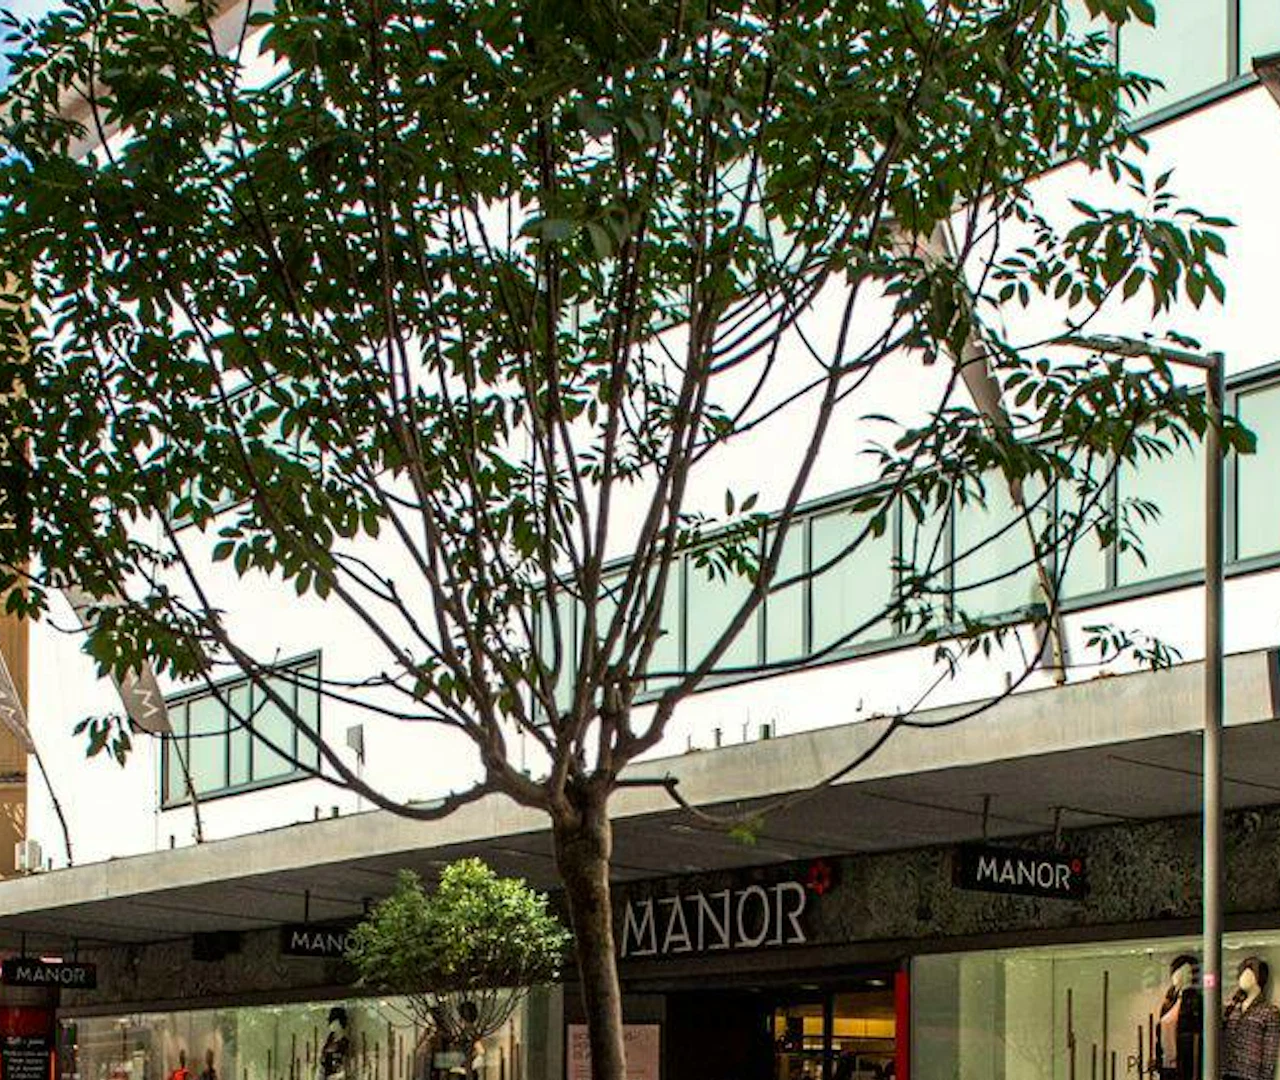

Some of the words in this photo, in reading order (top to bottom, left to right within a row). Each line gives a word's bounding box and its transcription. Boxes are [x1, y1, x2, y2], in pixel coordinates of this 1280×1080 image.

[976, 855, 1071, 891] MANOR
[620, 880, 807, 958] MANOR
[291, 931, 362, 954] MANO
[15, 965, 87, 984] MANOR
